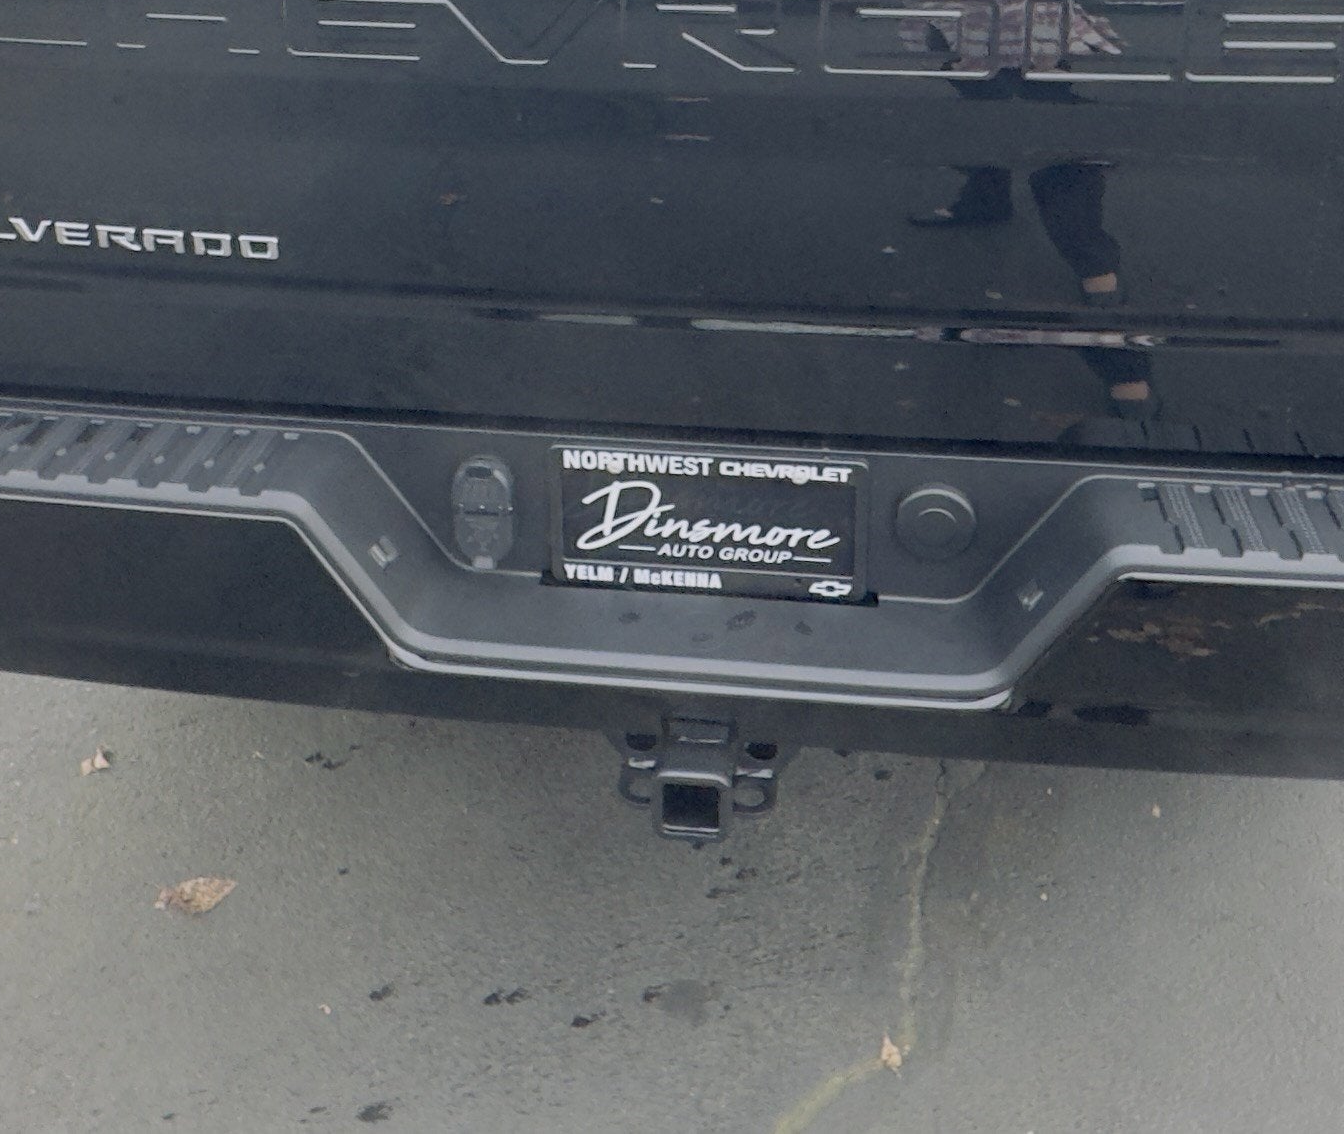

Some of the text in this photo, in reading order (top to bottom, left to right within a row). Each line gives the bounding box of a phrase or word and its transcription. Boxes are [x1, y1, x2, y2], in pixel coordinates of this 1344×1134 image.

[562, 449, 853, 483] NORTHWEST CHEVROLET
[576, 479, 841, 551] Dinsmore
[657, 542, 793, 564] AUTO GROUP
[564, 563, 614, 582] YELM
[634, 569, 723, 590] McKENNA
